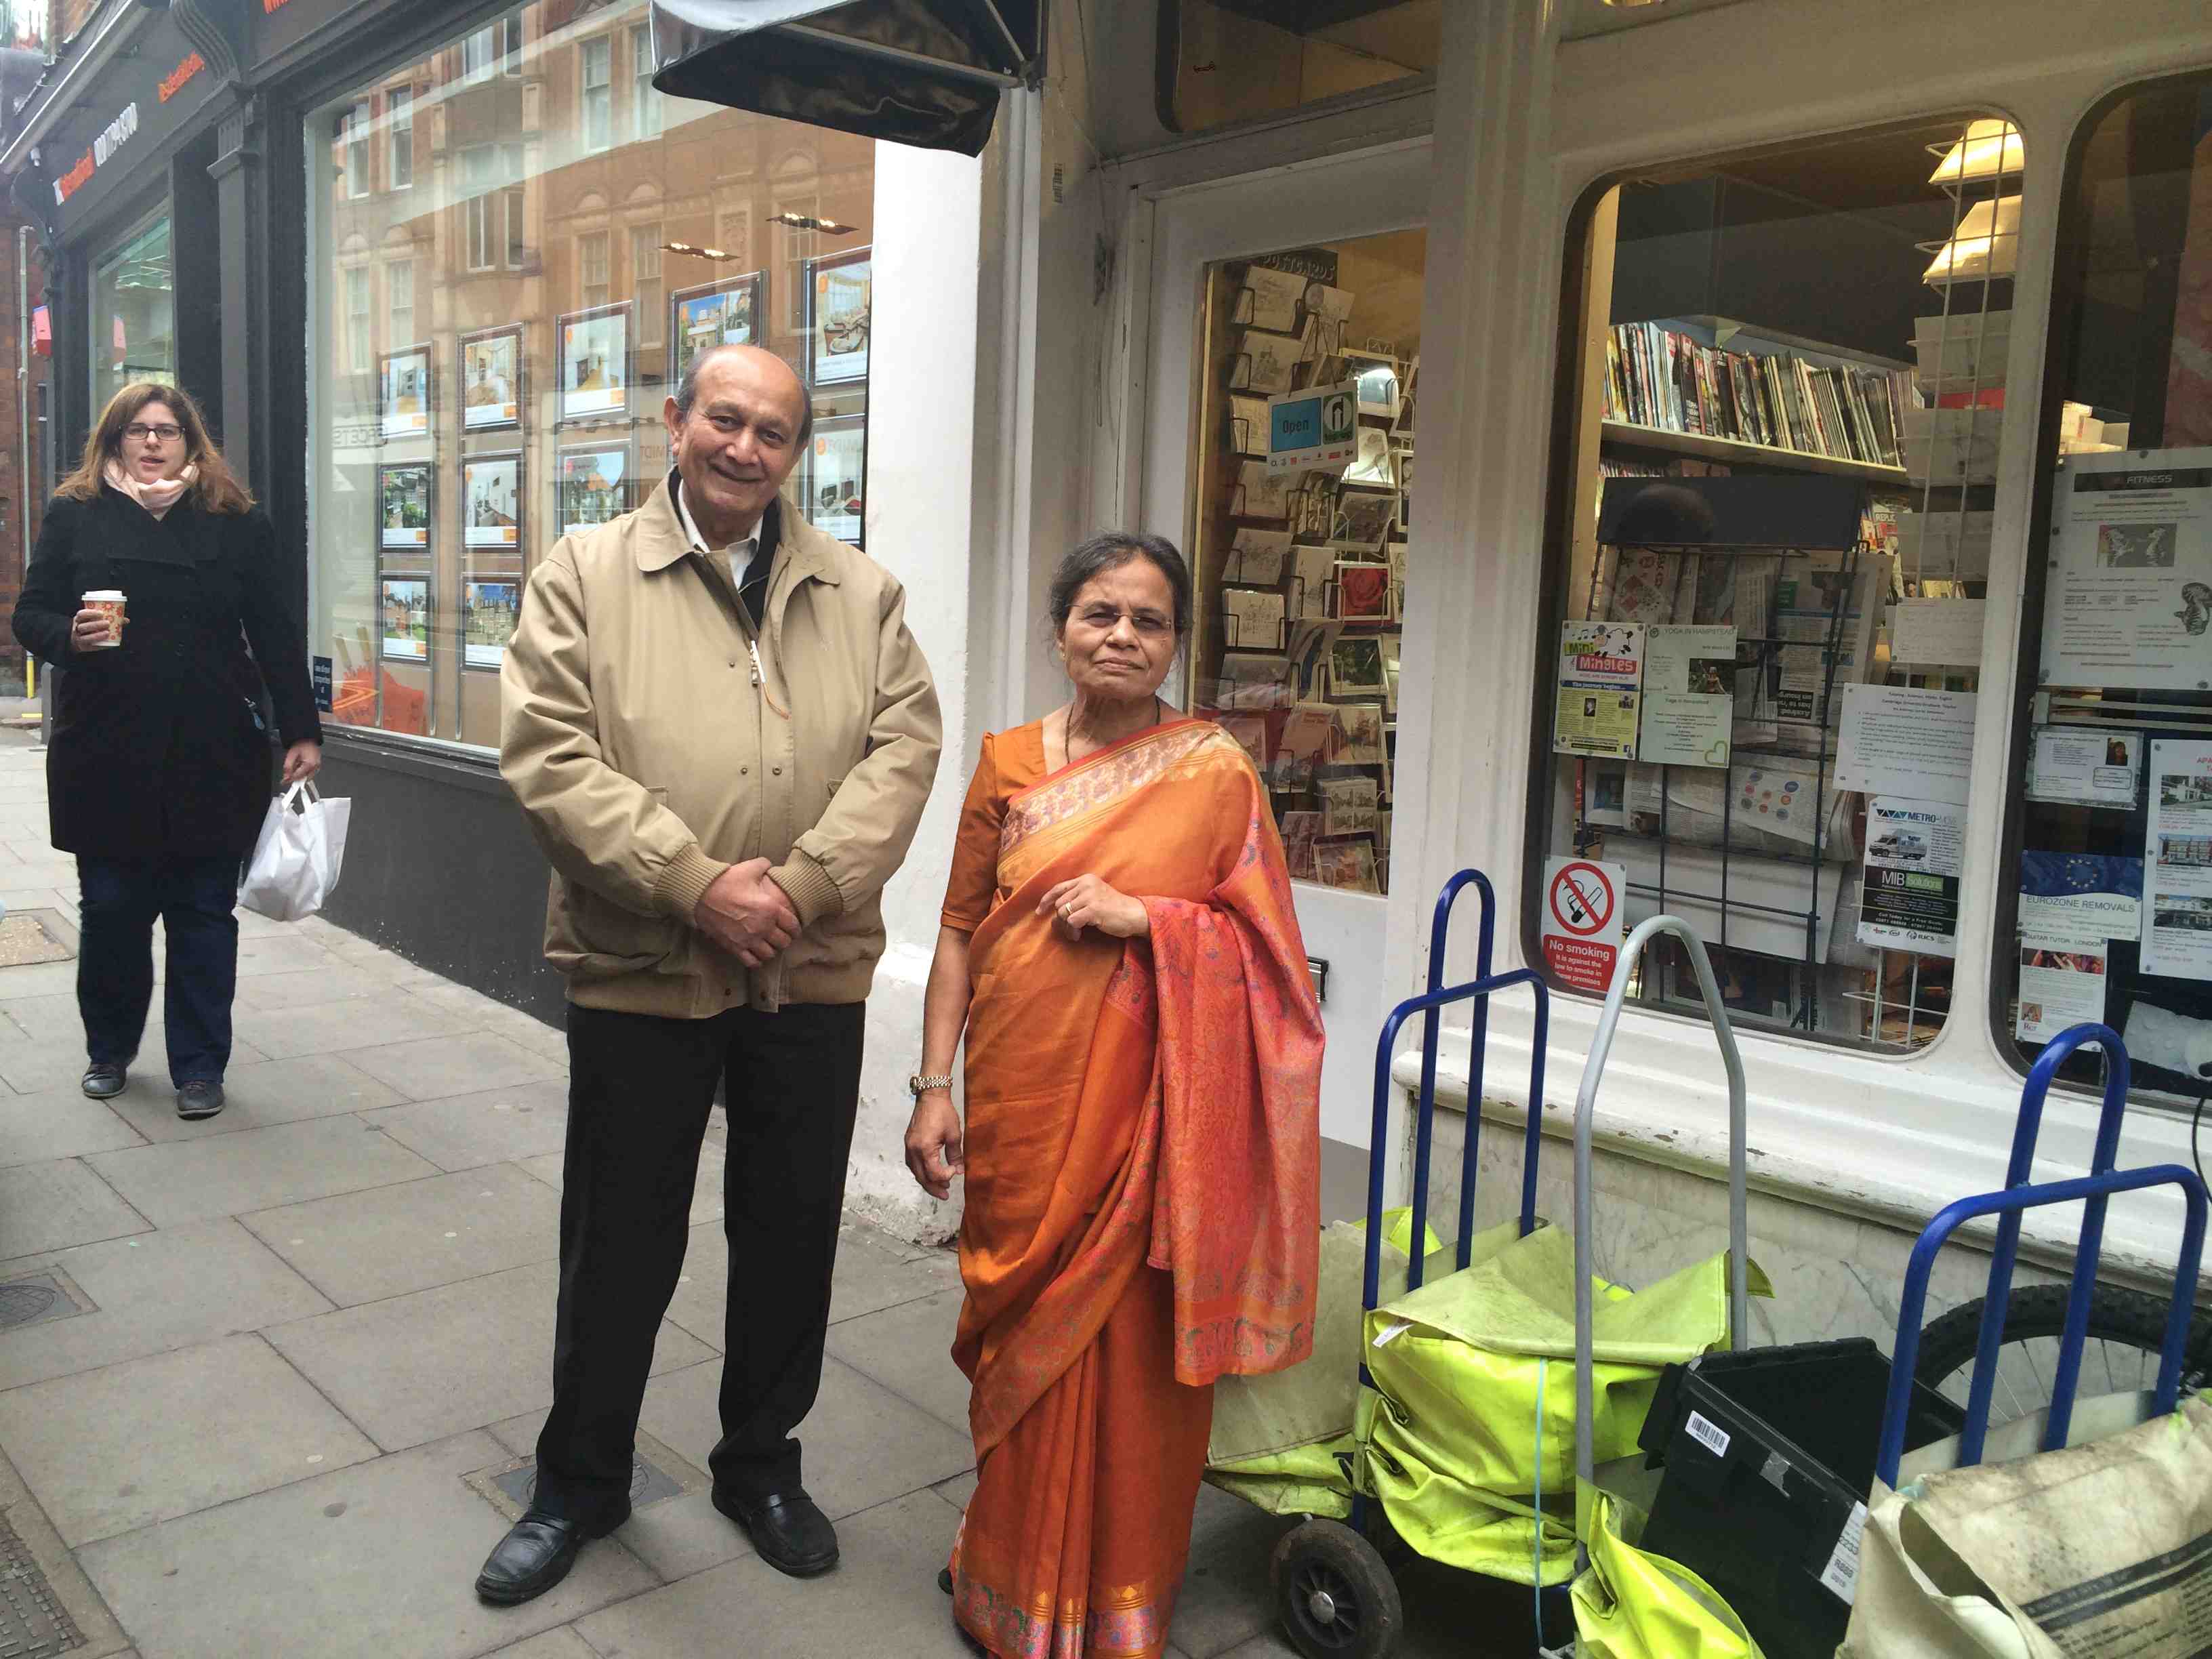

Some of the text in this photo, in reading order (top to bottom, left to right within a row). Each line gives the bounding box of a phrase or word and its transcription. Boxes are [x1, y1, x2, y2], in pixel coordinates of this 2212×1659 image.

[1283, 419, 1309, 434] Open
[2125, 474, 2173, 483] FITNESS
[1570, 642, 1595, 654] Mini
[1579, 656, 1634, 672] Mingles
[1881, 871, 1905, 886] MIB
[2026, 895, 2135, 913] EUROZONE REMOVALS
[2049, 936, 2071, 944] TUTOR
[1549, 939, 1610, 962] No smoking
[1568, 957, 1591, 966] against
[1574, 967, 1595, 975] smoke
